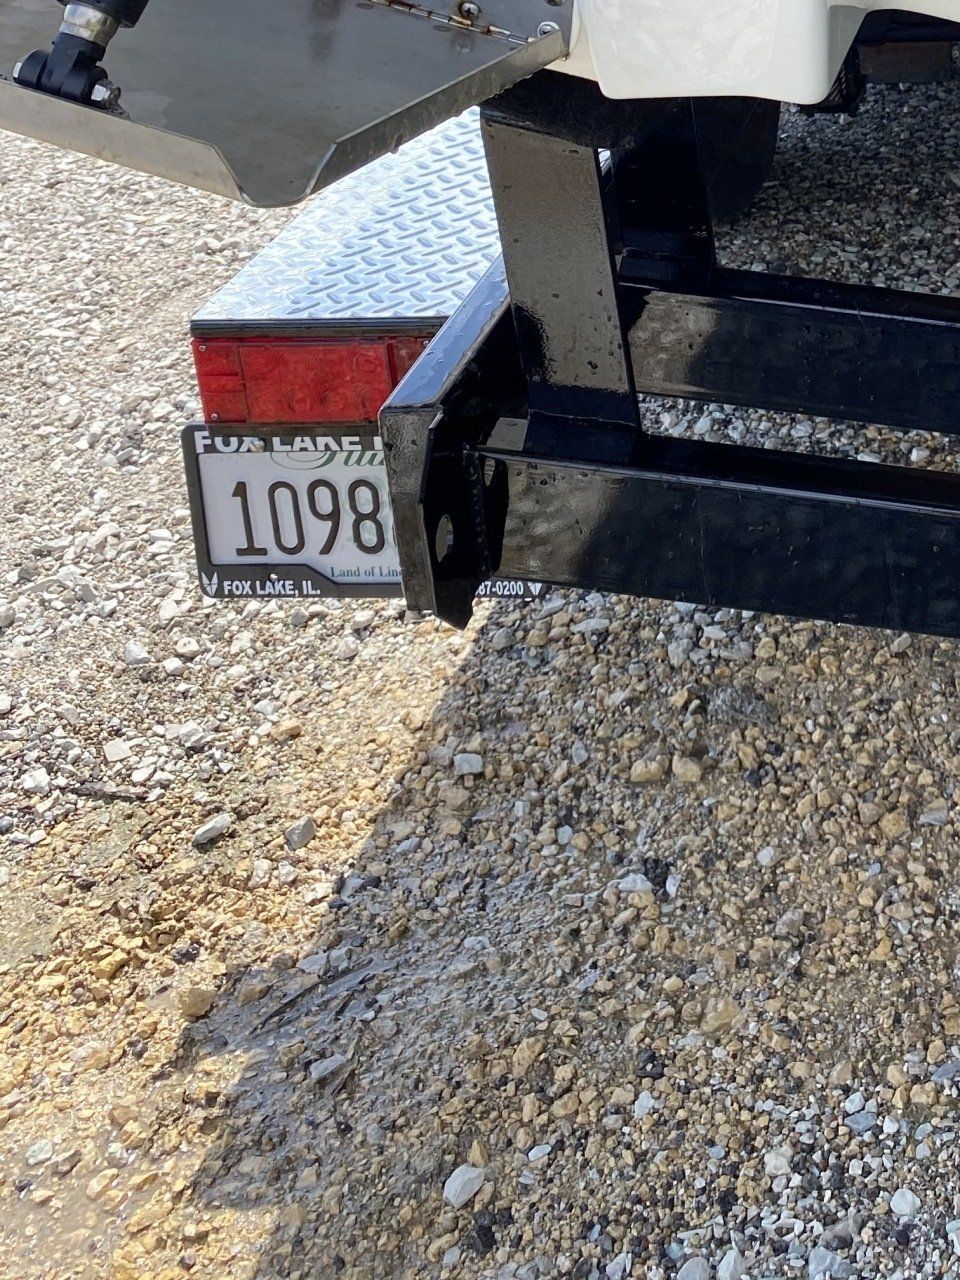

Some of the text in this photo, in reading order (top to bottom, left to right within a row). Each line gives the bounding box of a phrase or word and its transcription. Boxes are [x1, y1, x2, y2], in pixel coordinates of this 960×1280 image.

[231, 478, 386, 557] 1098
[330, 566, 362, 578] Land
[364, 566, 377, 578] of
[223, 579, 321, 597] FOX LAKE, IL.
[475, 580, 524, 596] 87-0200
